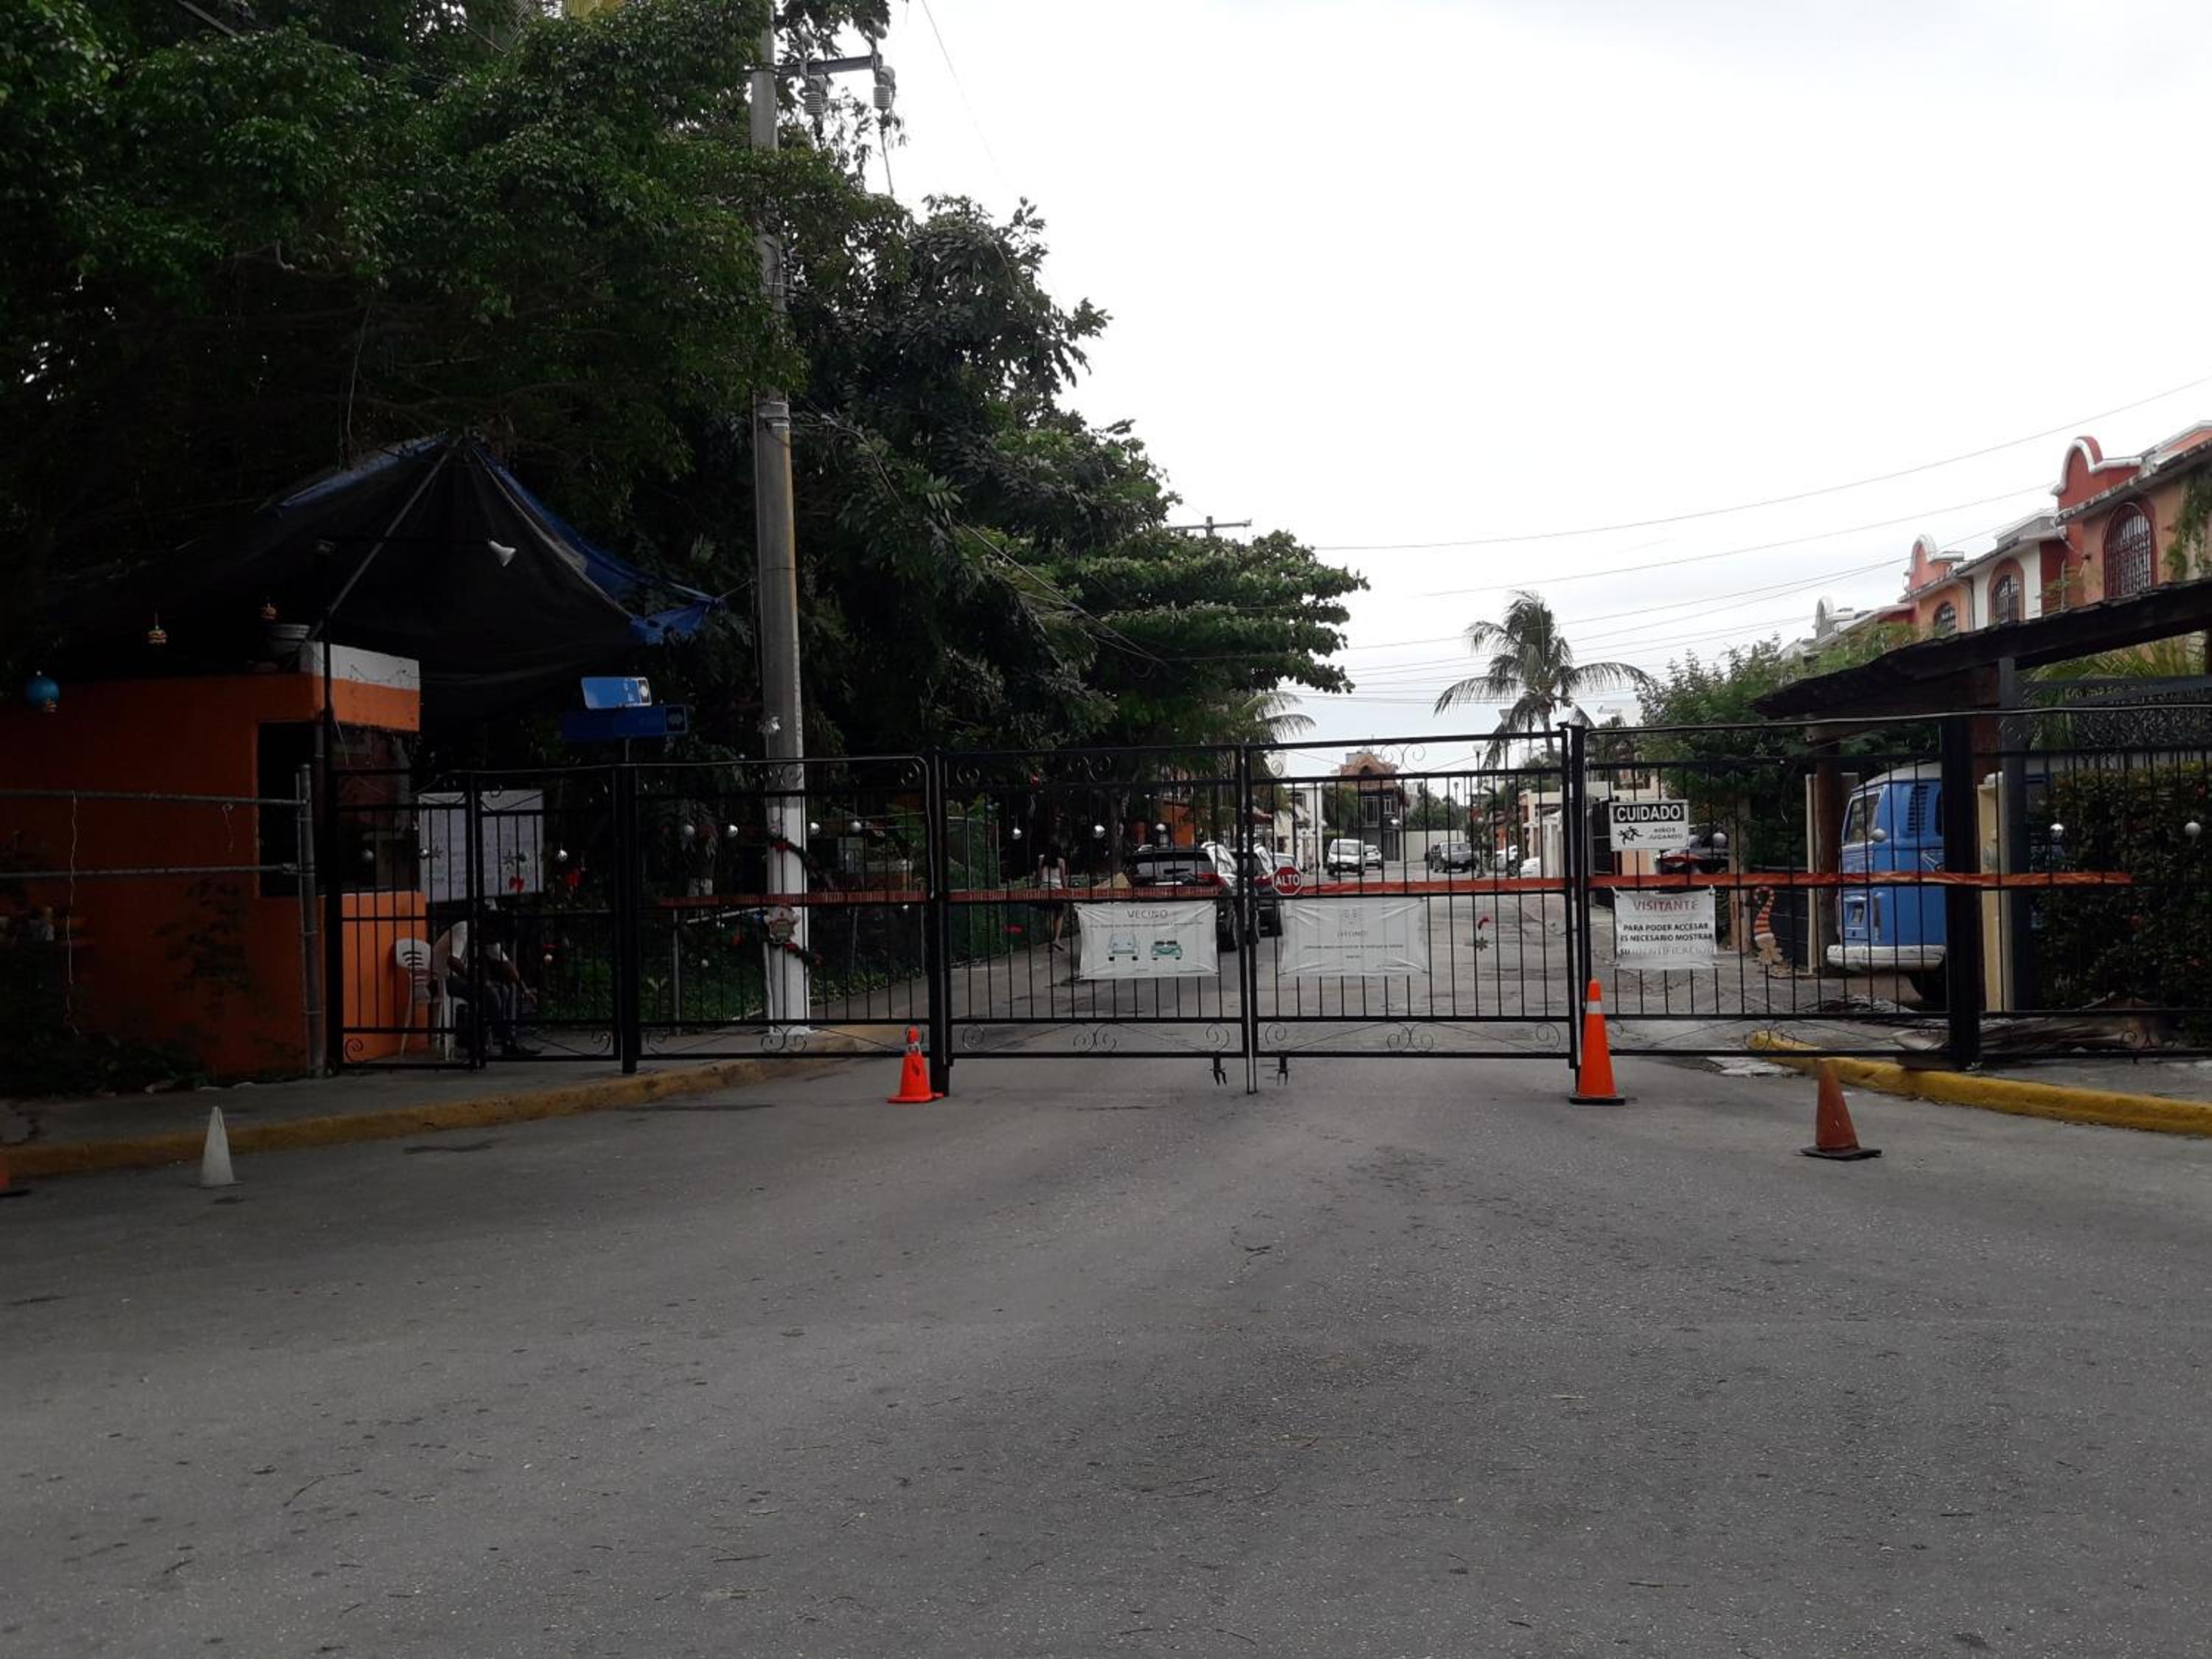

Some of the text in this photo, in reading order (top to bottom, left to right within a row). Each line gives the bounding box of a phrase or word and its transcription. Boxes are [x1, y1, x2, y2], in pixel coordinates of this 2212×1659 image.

[1616, 804, 1680, 821] CUIDADO
[1276, 874, 1300, 886] ALTO
[1633, 900, 1698, 911] VISITANTE
[1127, 909, 1169, 919] VECINO
[1675, 932, 1713, 940] MOSTRAR
